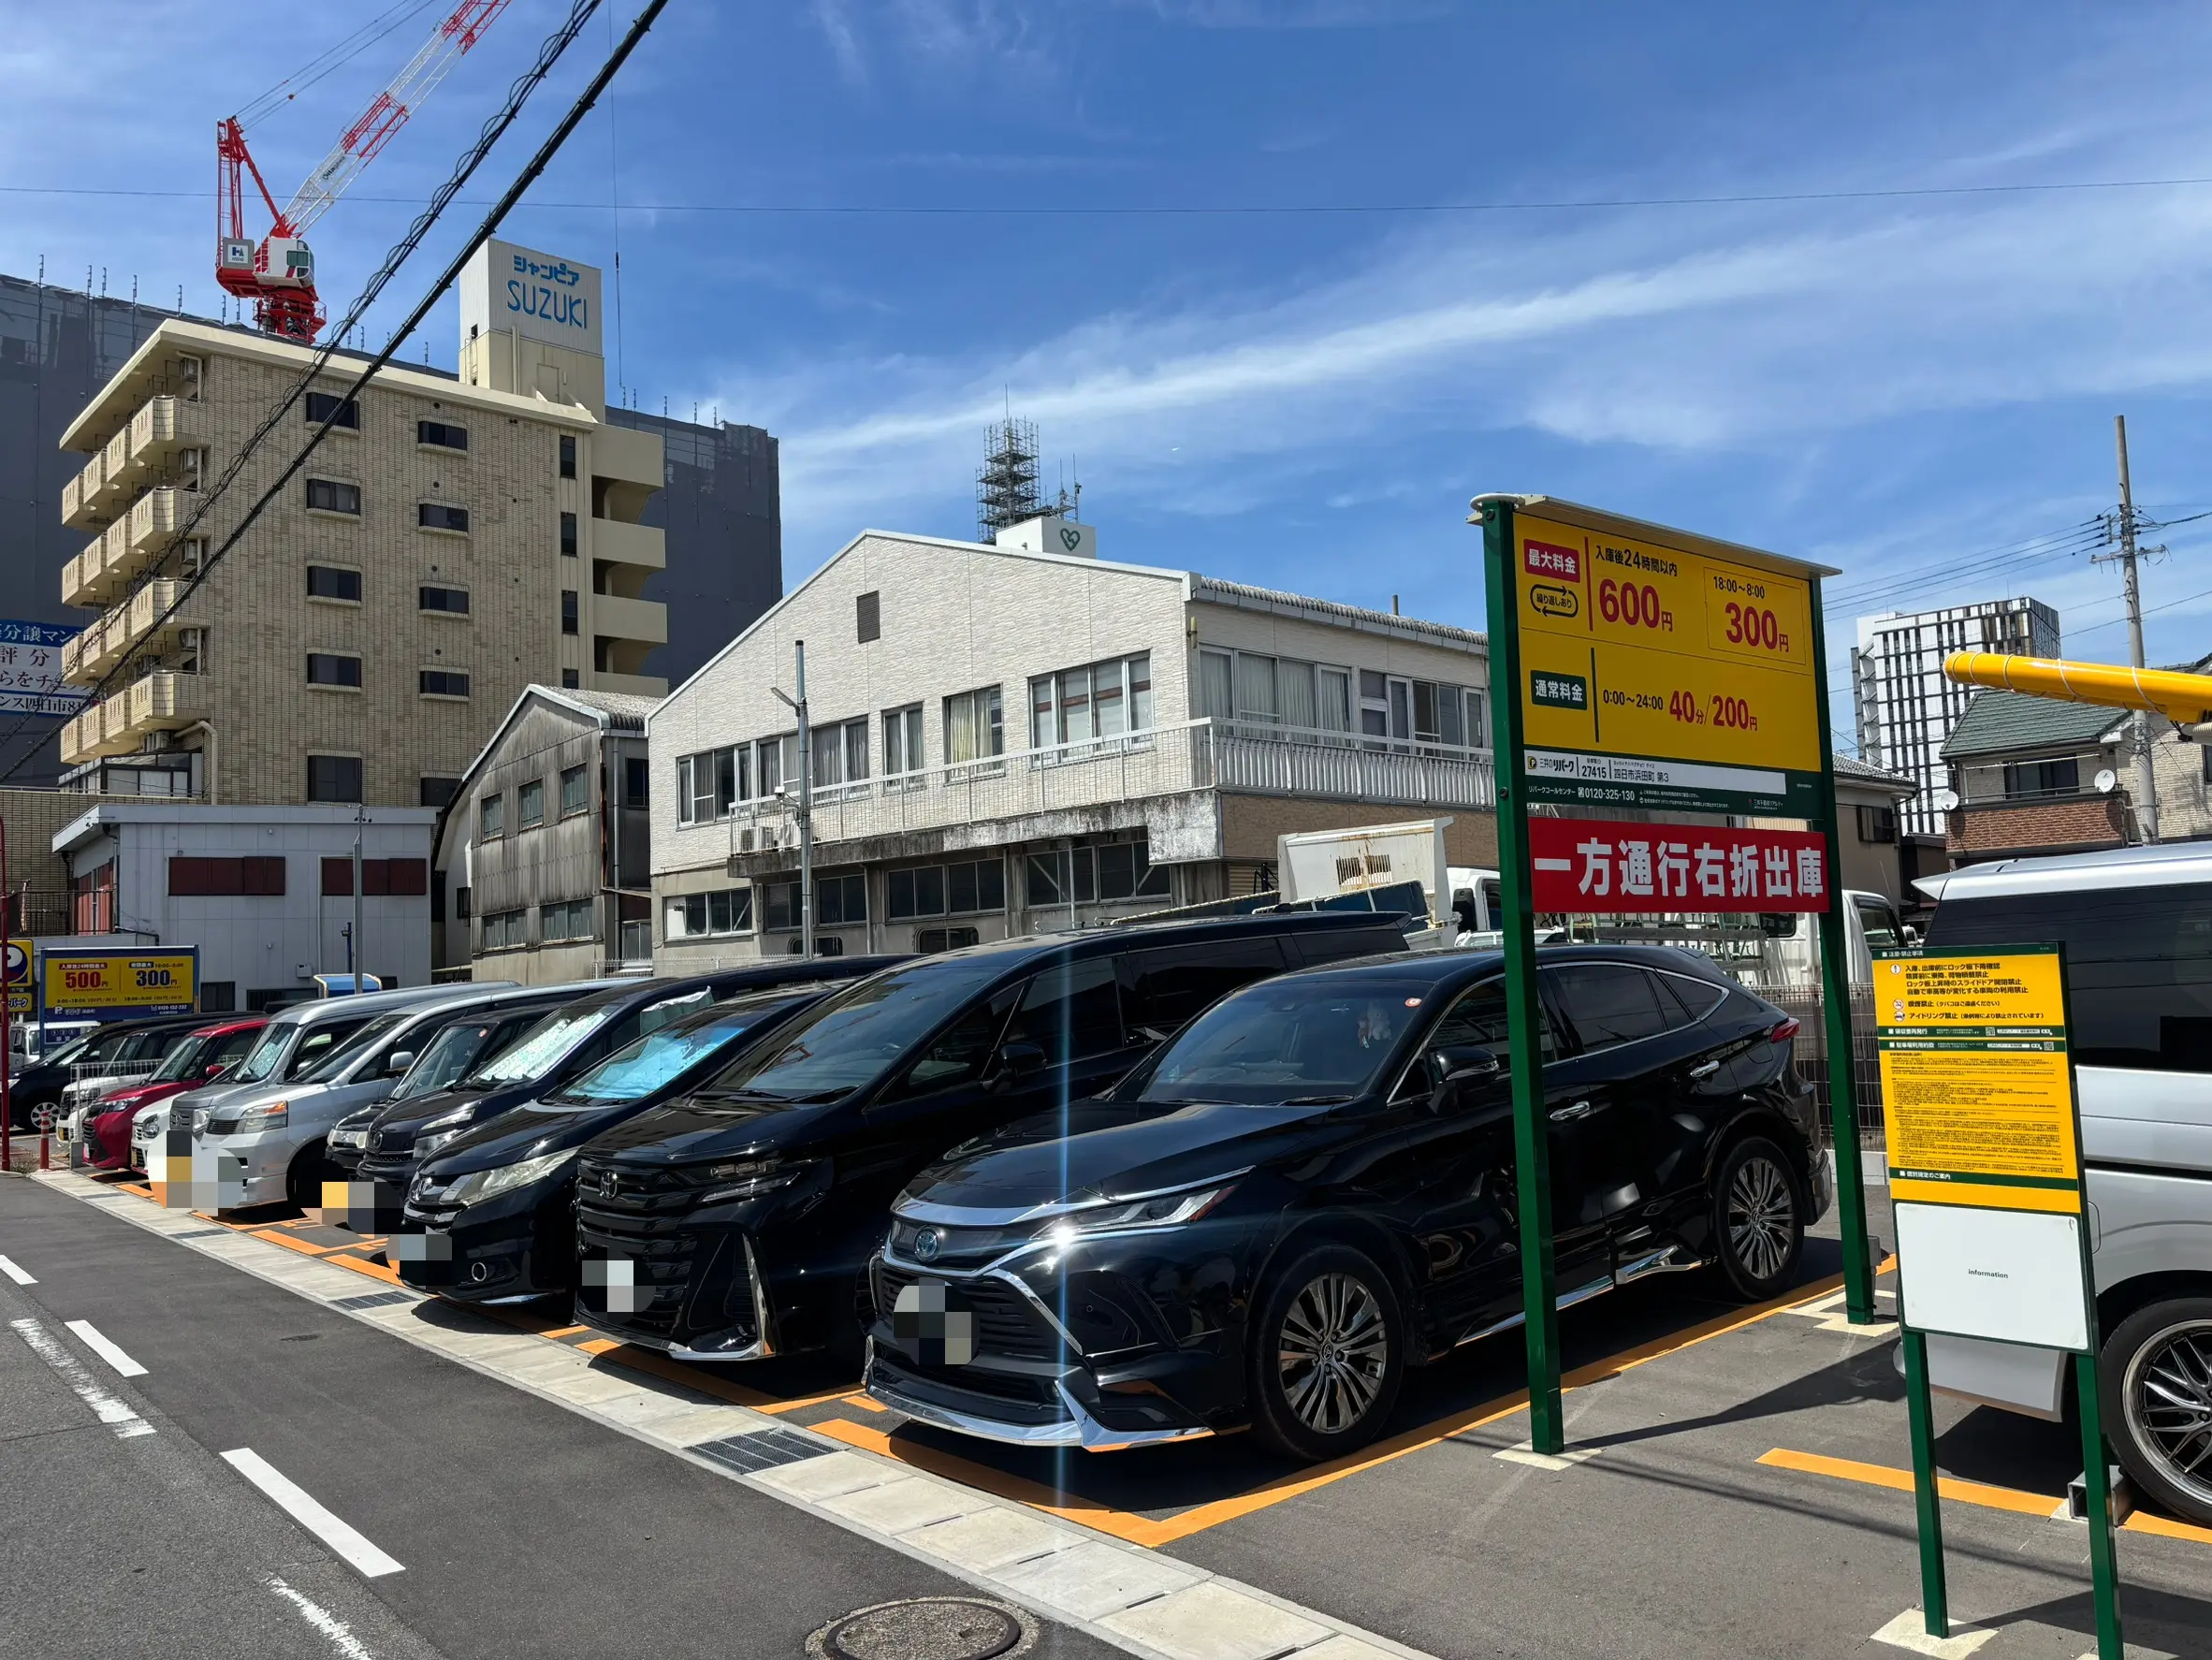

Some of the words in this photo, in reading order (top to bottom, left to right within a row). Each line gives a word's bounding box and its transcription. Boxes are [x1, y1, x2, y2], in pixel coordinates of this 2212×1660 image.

[514, 255, 579, 286] シャンピア
[507, 280, 587, 329] SUZUKI
[1528, 548, 1576, 575] 最大料金
[1595, 545, 1678, 576] 入庫後24時間以内
[1536, 592, 1572, 608] 繰り返しあり
[1599, 577, 1673, 632] 600円
[0, 623, 84, 643] 分譲マン
[1724, 602, 1789, 652] 300円
[0, 670, 91, 692] らをチェ
[1535, 679, 1583, 702] 通常料金
[1669, 691, 1758, 732] 40分/200円
[1539, 757, 1575, 773] 三井のリパーク
[1581, 764, 1608, 779] 27415
[1613, 768, 1655, 782] 四日市浜田町
[1657, 771, 1669, 783] 第3
[1528, 785, 1576, 794] リパークコールセンター
[1584, 787, 1636, 802] 0120-325-130
[1535, 837, 1824, 897] 一方通行右折出庫
[65, 971, 109, 989] 500円
[136, 969, 177, 986] 300円
[1968, 1268, 2009, 1279] information
